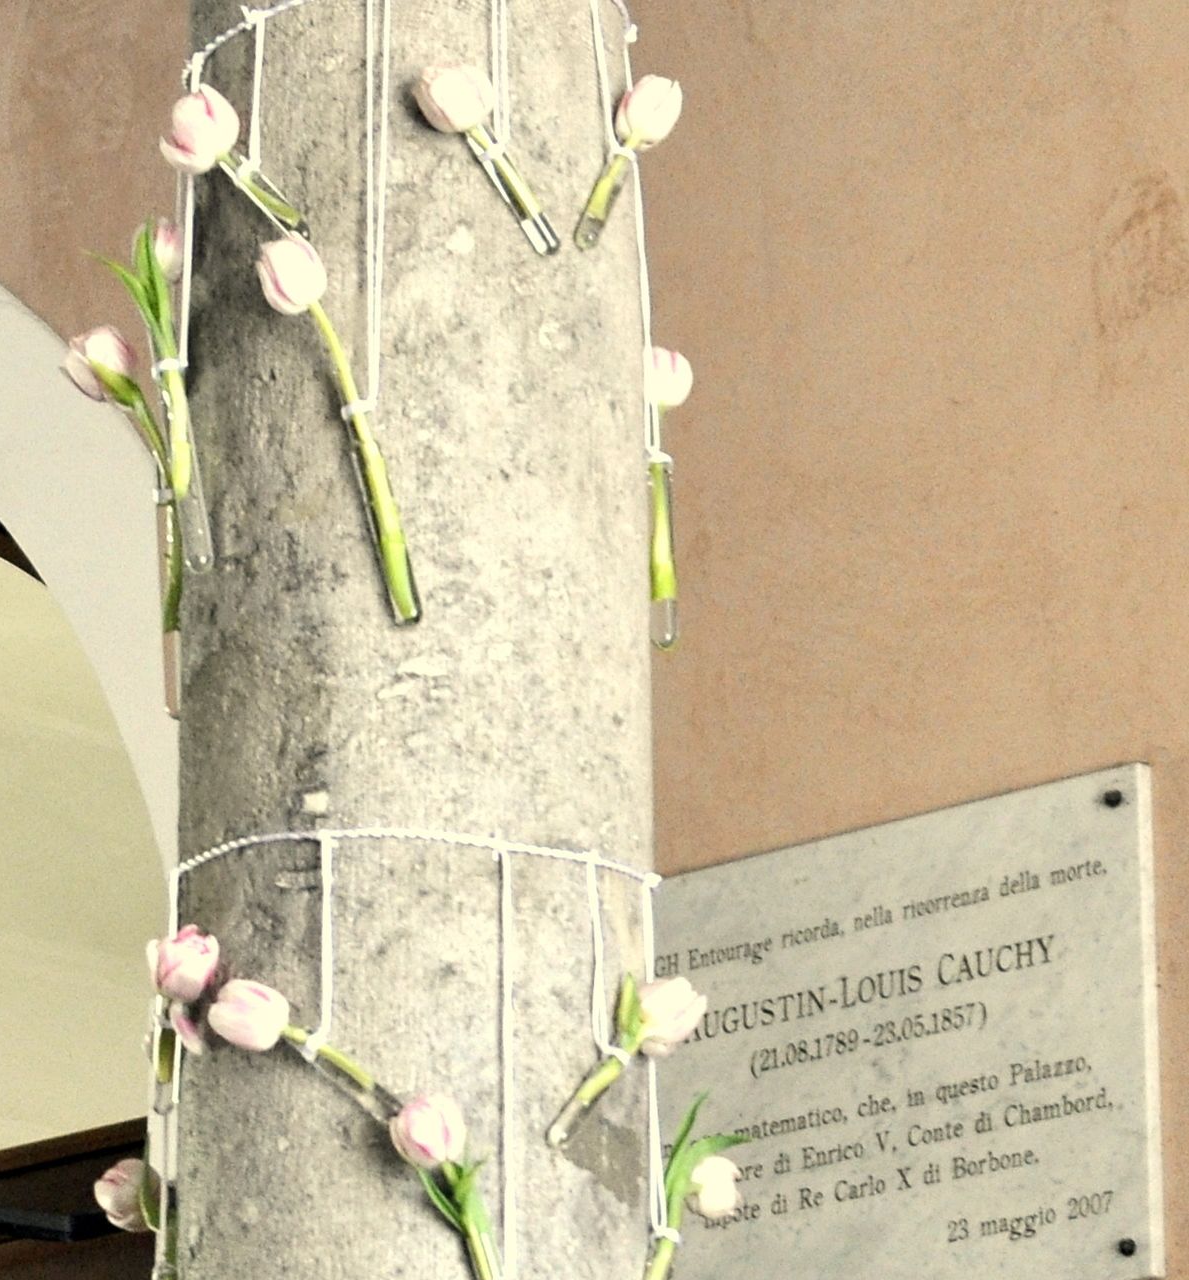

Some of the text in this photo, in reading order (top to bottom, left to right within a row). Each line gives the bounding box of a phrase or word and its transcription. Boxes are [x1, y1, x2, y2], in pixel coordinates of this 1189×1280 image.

[688, 937, 772, 970] Entourage
[781, 918, 845, 948] ricorda,
[853, 905, 894, 931] nella
[902, 887, 990, 920] ricorrenza
[999, 870, 1041, 897] della
[1050, 858, 1108, 886] morte,
[937, 934, 1055, 986] CAUCHY
[857, 1095, 897, 1118] che,
[906, 1088, 925, 1108] in
[935, 1073, 1000, 1104] questo
[1009, 1055, 1092, 1086] Palazzo,
[773, 1152, 791, 1175] di
[801, 1140, 864, 1169] Enrico
[907, 1121, 964, 1147] Conte
[974, 1111, 993, 1135] di
[1004, 1087, 1114, 1127] Chambord,
[770, 1194, 788, 1215] di
[798, 1187, 824, 1210] Re
[834, 1175, 886, 1202] Carlo
[896, 1168, 912, 1191] X
[923, 1163, 941, 1185] di
[947, 1190, 1114, 1243] 23 maggio 2007
